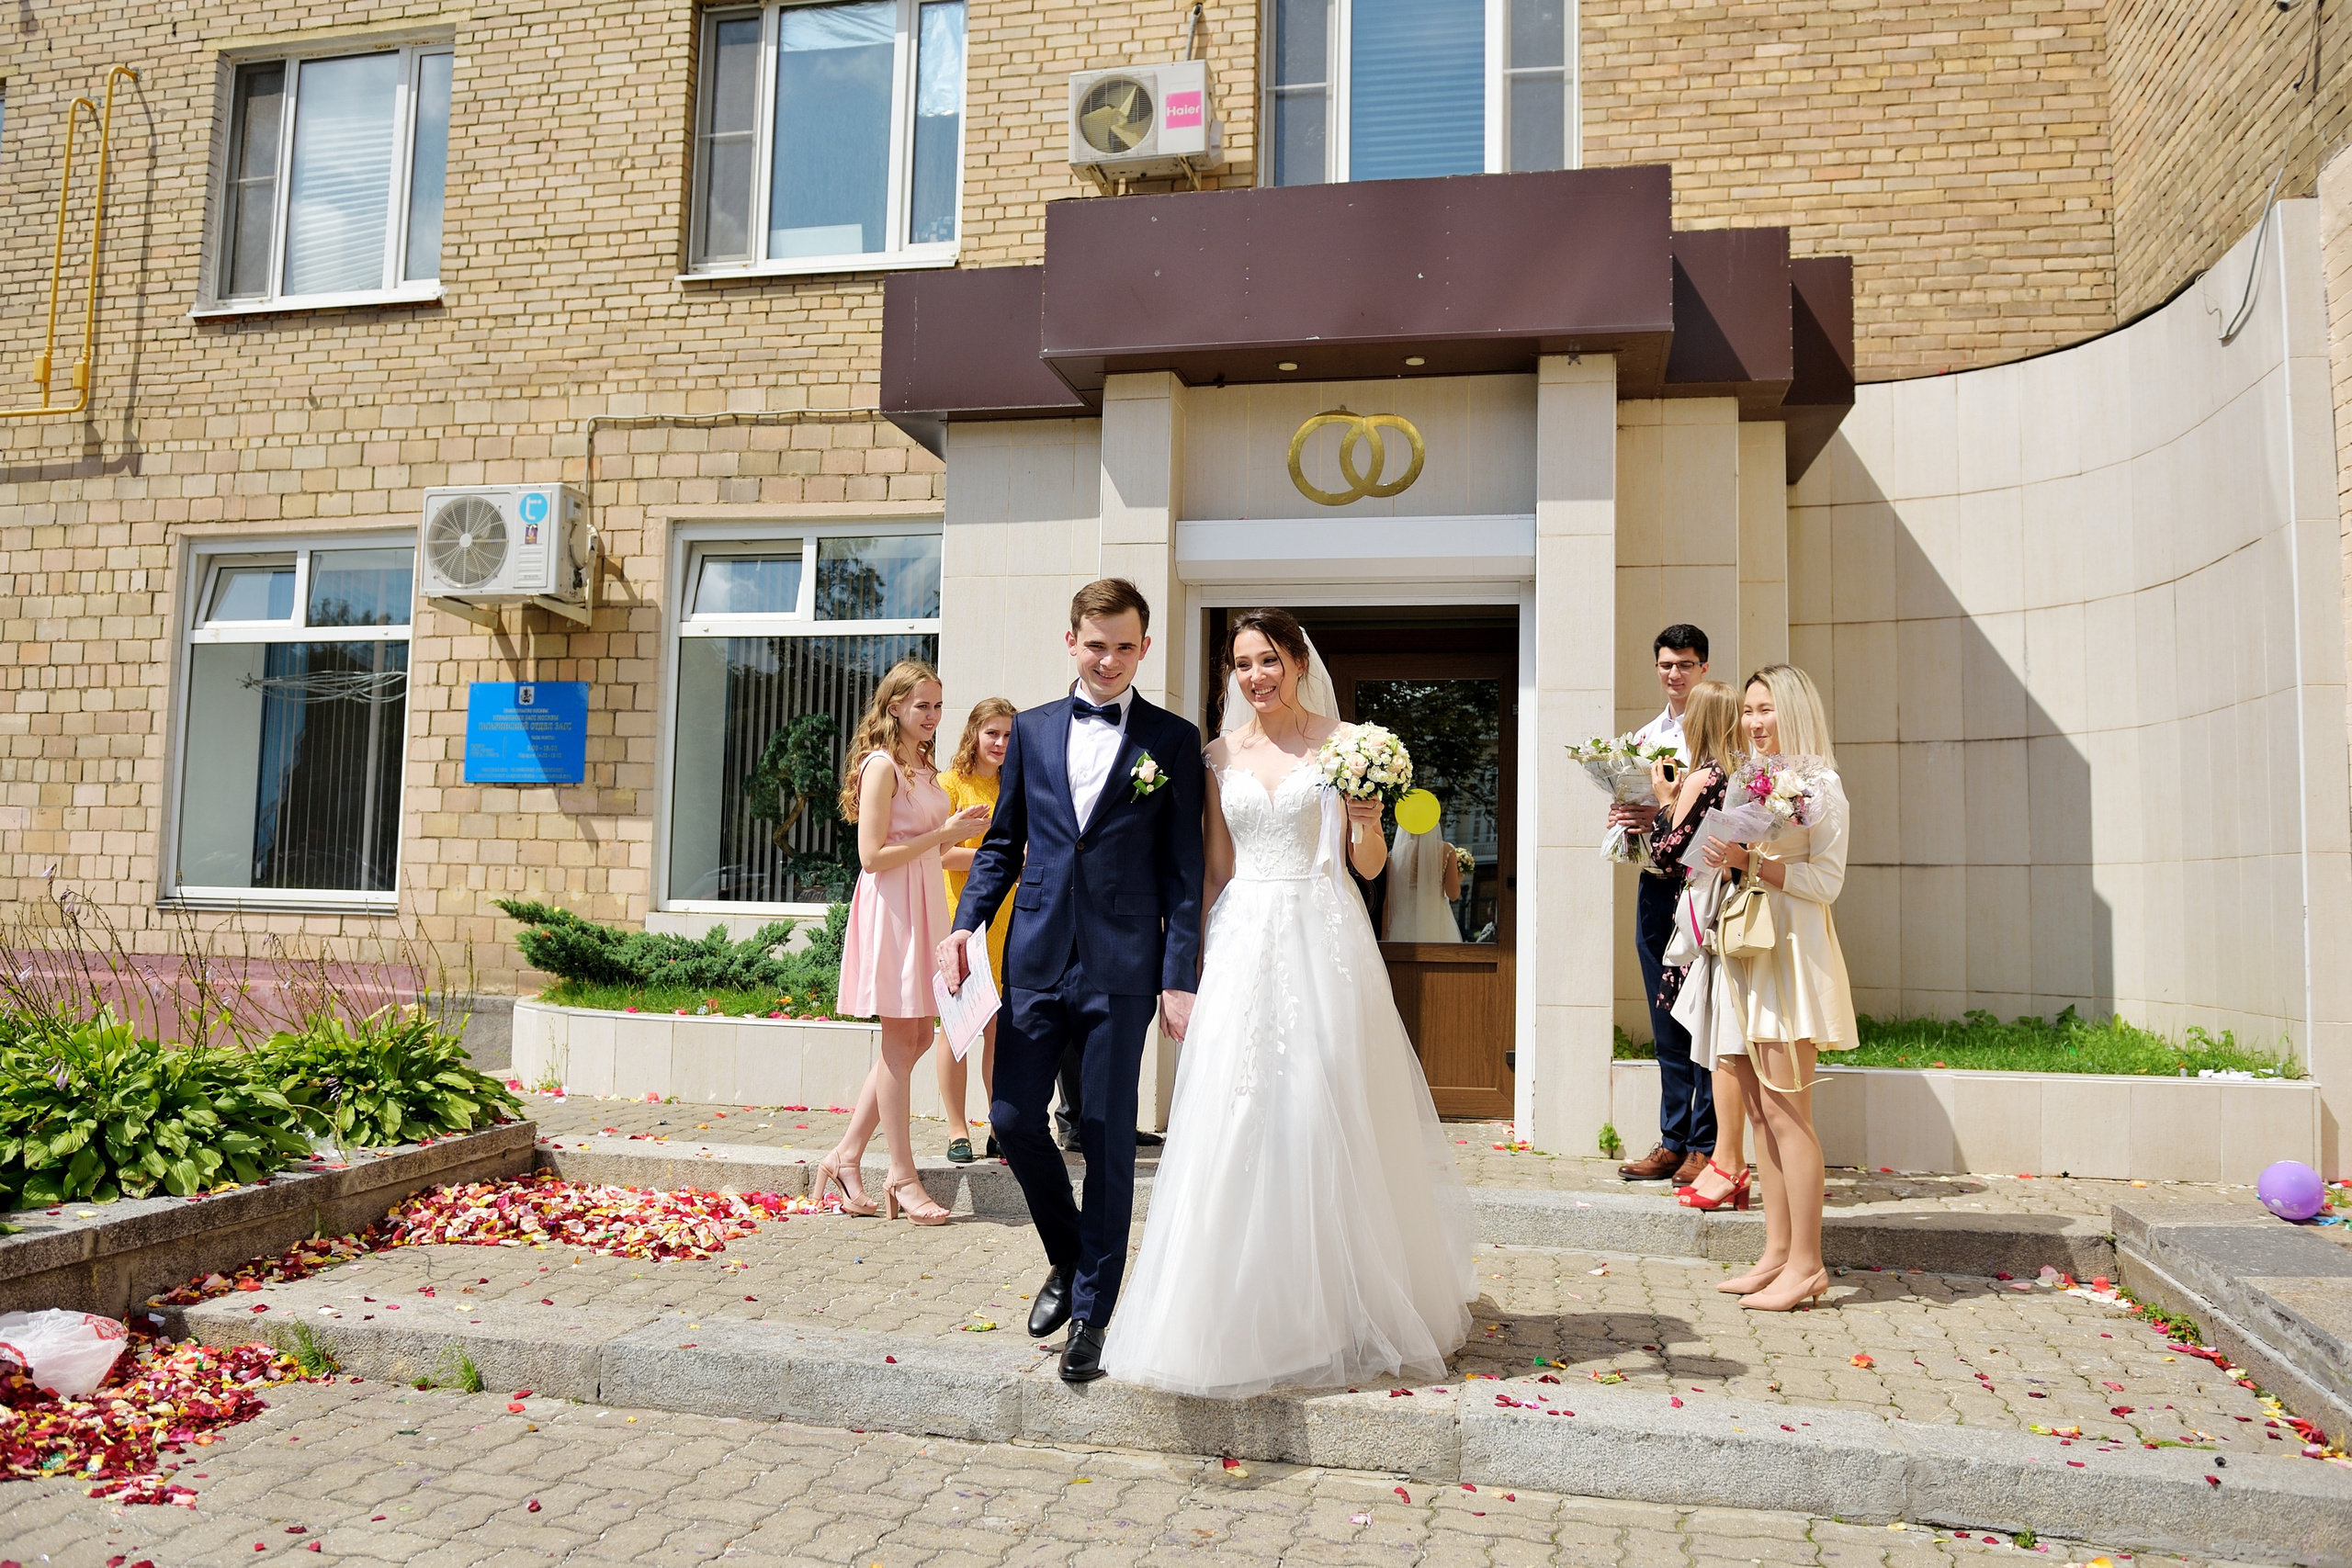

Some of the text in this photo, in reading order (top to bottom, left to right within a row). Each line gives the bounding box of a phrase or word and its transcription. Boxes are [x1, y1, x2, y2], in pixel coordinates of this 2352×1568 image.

[1166, 104, 1201, 117] Haier
[479, 721, 572, 731] ГАГАРИНСКИЙ ОТДЕЛ ЗАГС
